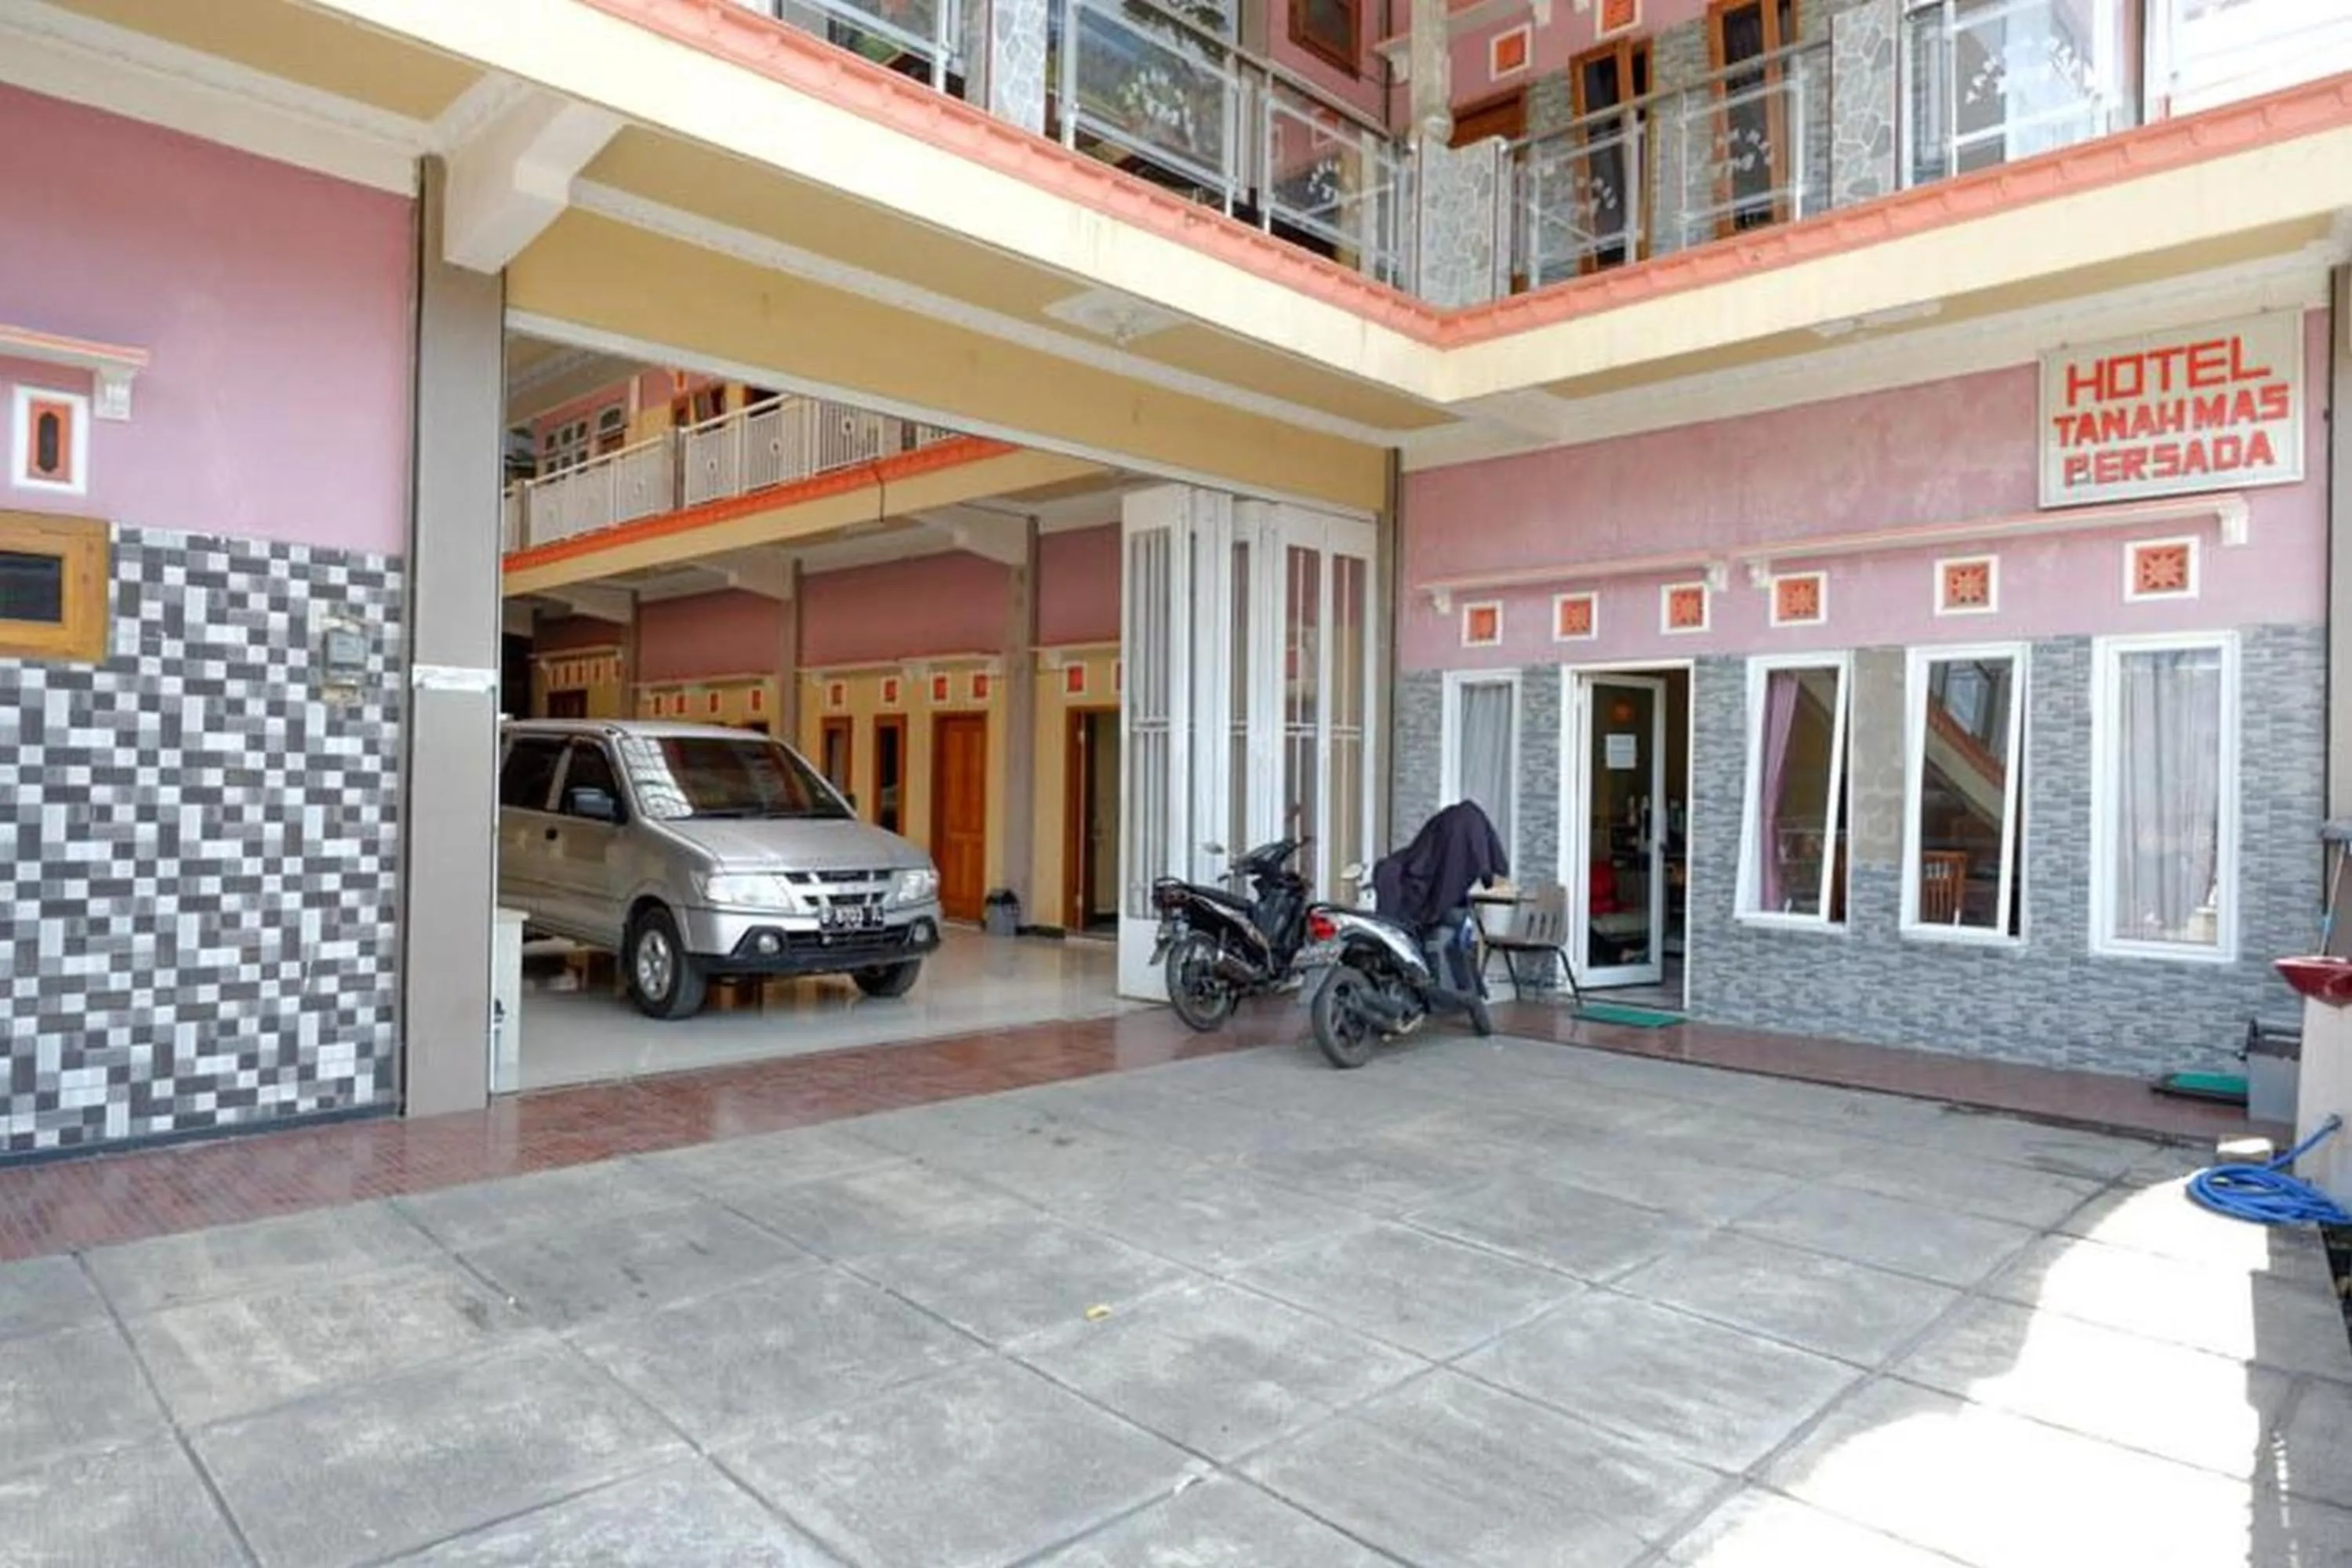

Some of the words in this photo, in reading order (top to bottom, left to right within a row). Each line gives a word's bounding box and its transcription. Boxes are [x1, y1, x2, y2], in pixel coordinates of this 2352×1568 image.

[2066, 336, 2271, 406] HOTEL
[2053, 396, 2185, 448] TANAH
[2193, 383, 2289, 430] MAS
[2063, 430, 2275, 487] PERSADA
